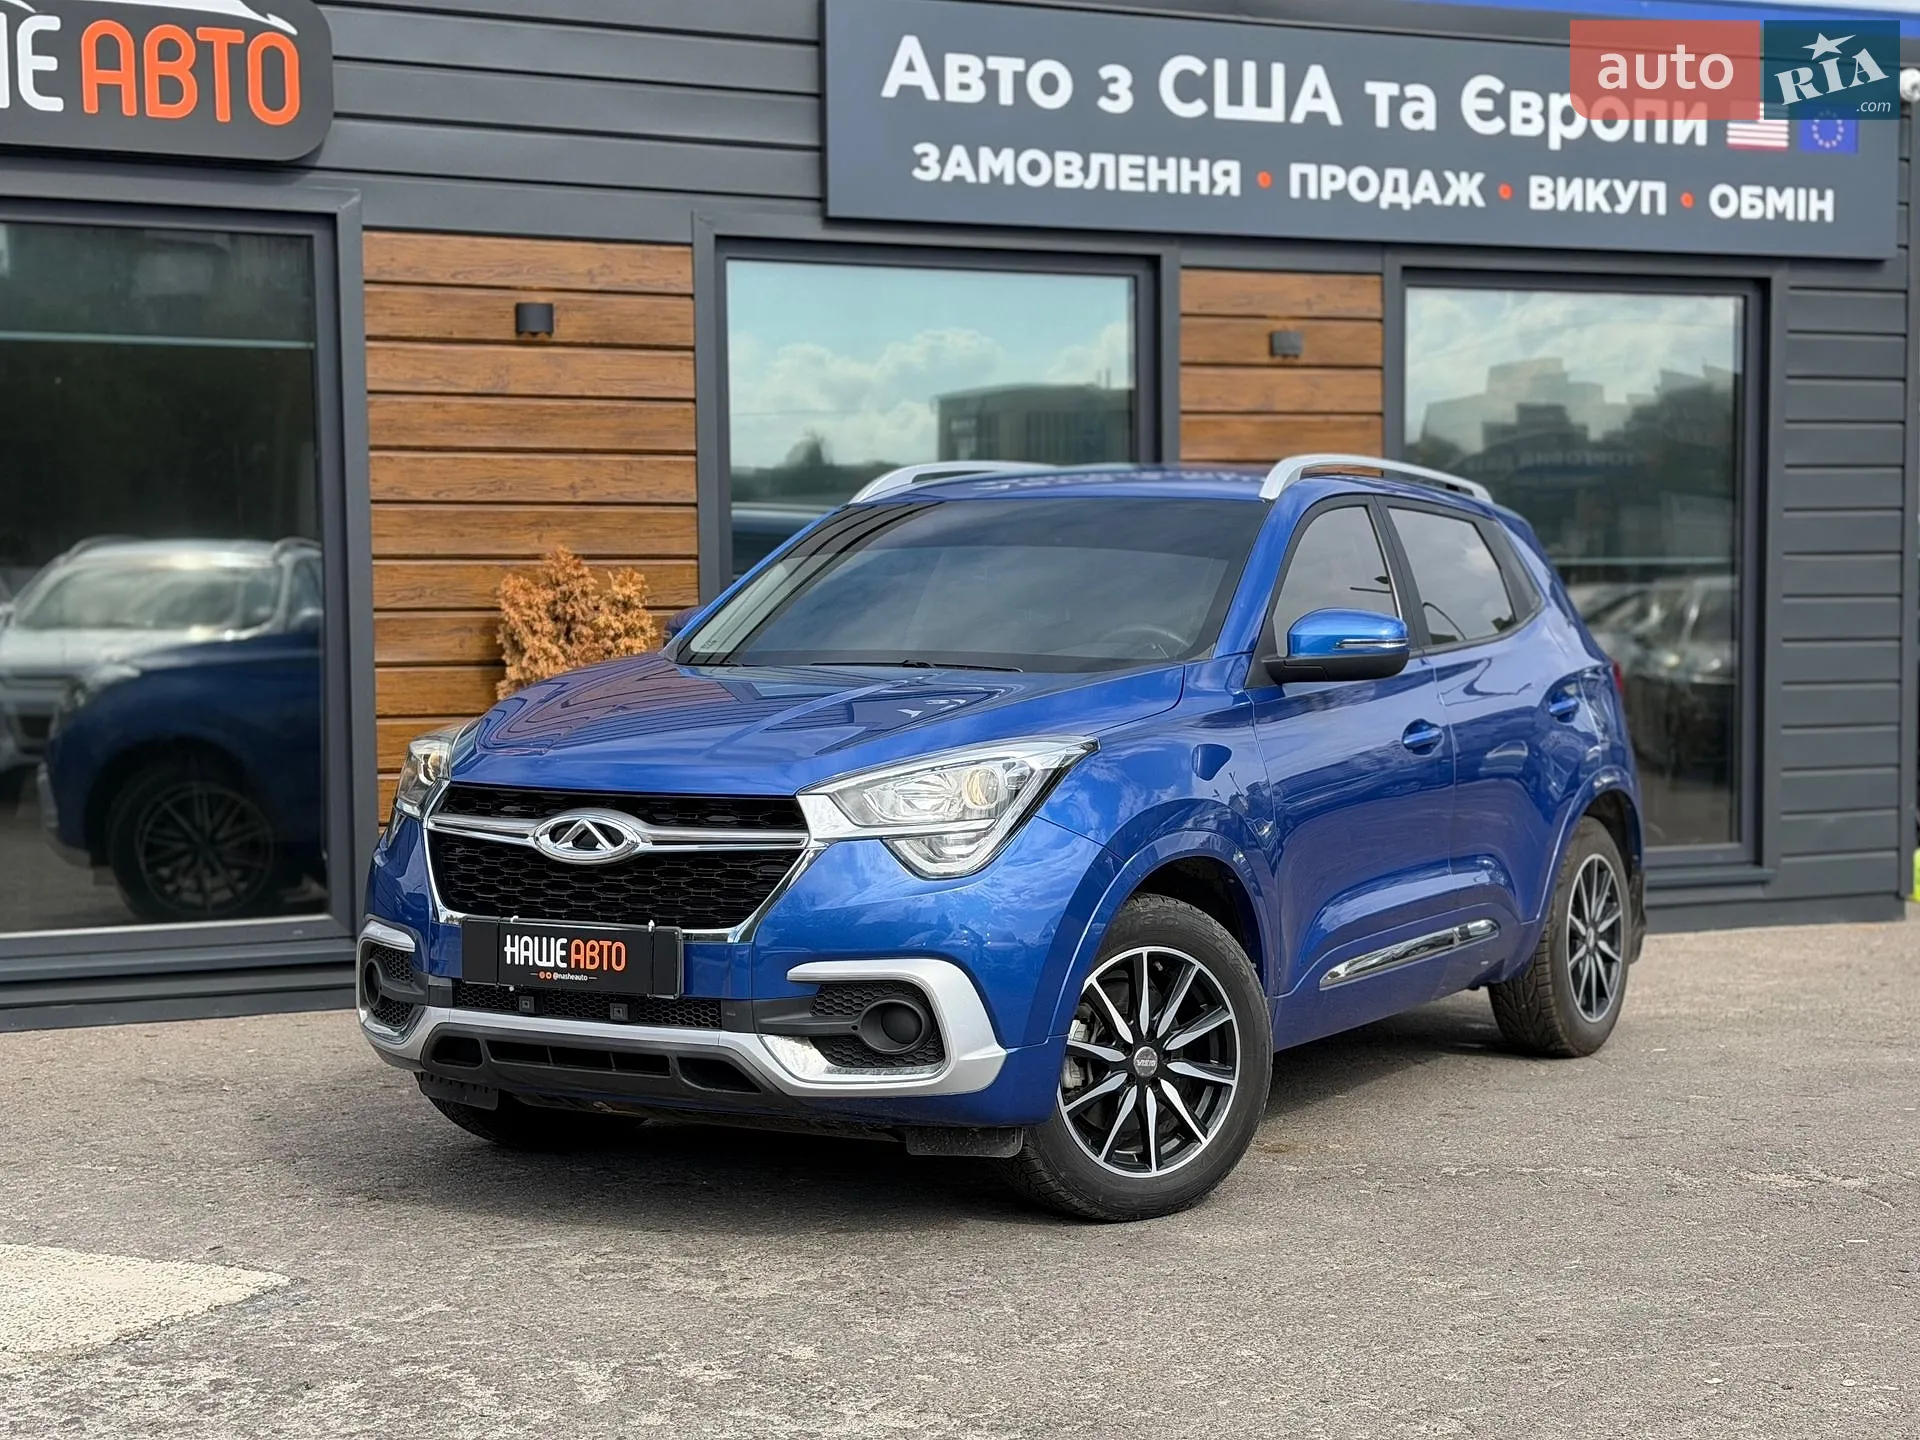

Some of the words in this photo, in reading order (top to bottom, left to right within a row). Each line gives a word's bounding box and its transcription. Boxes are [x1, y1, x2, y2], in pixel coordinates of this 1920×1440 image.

[81, 20, 300, 126] АВТО
[1097, 64, 1134, 114] з
[1158, 55, 1343, 126] США
[1364, 81, 1437, 132] та
[1460, 73, 1708, 151] Європи
[911, 142, 1241, 197] ЗАМОВЛЕННЯ
[1289, 163, 1486, 210] ПРОДАЖ
[1528, 175, 1668, 215] ВИКУП
[1708, 184, 1835, 223] ОБМІН
